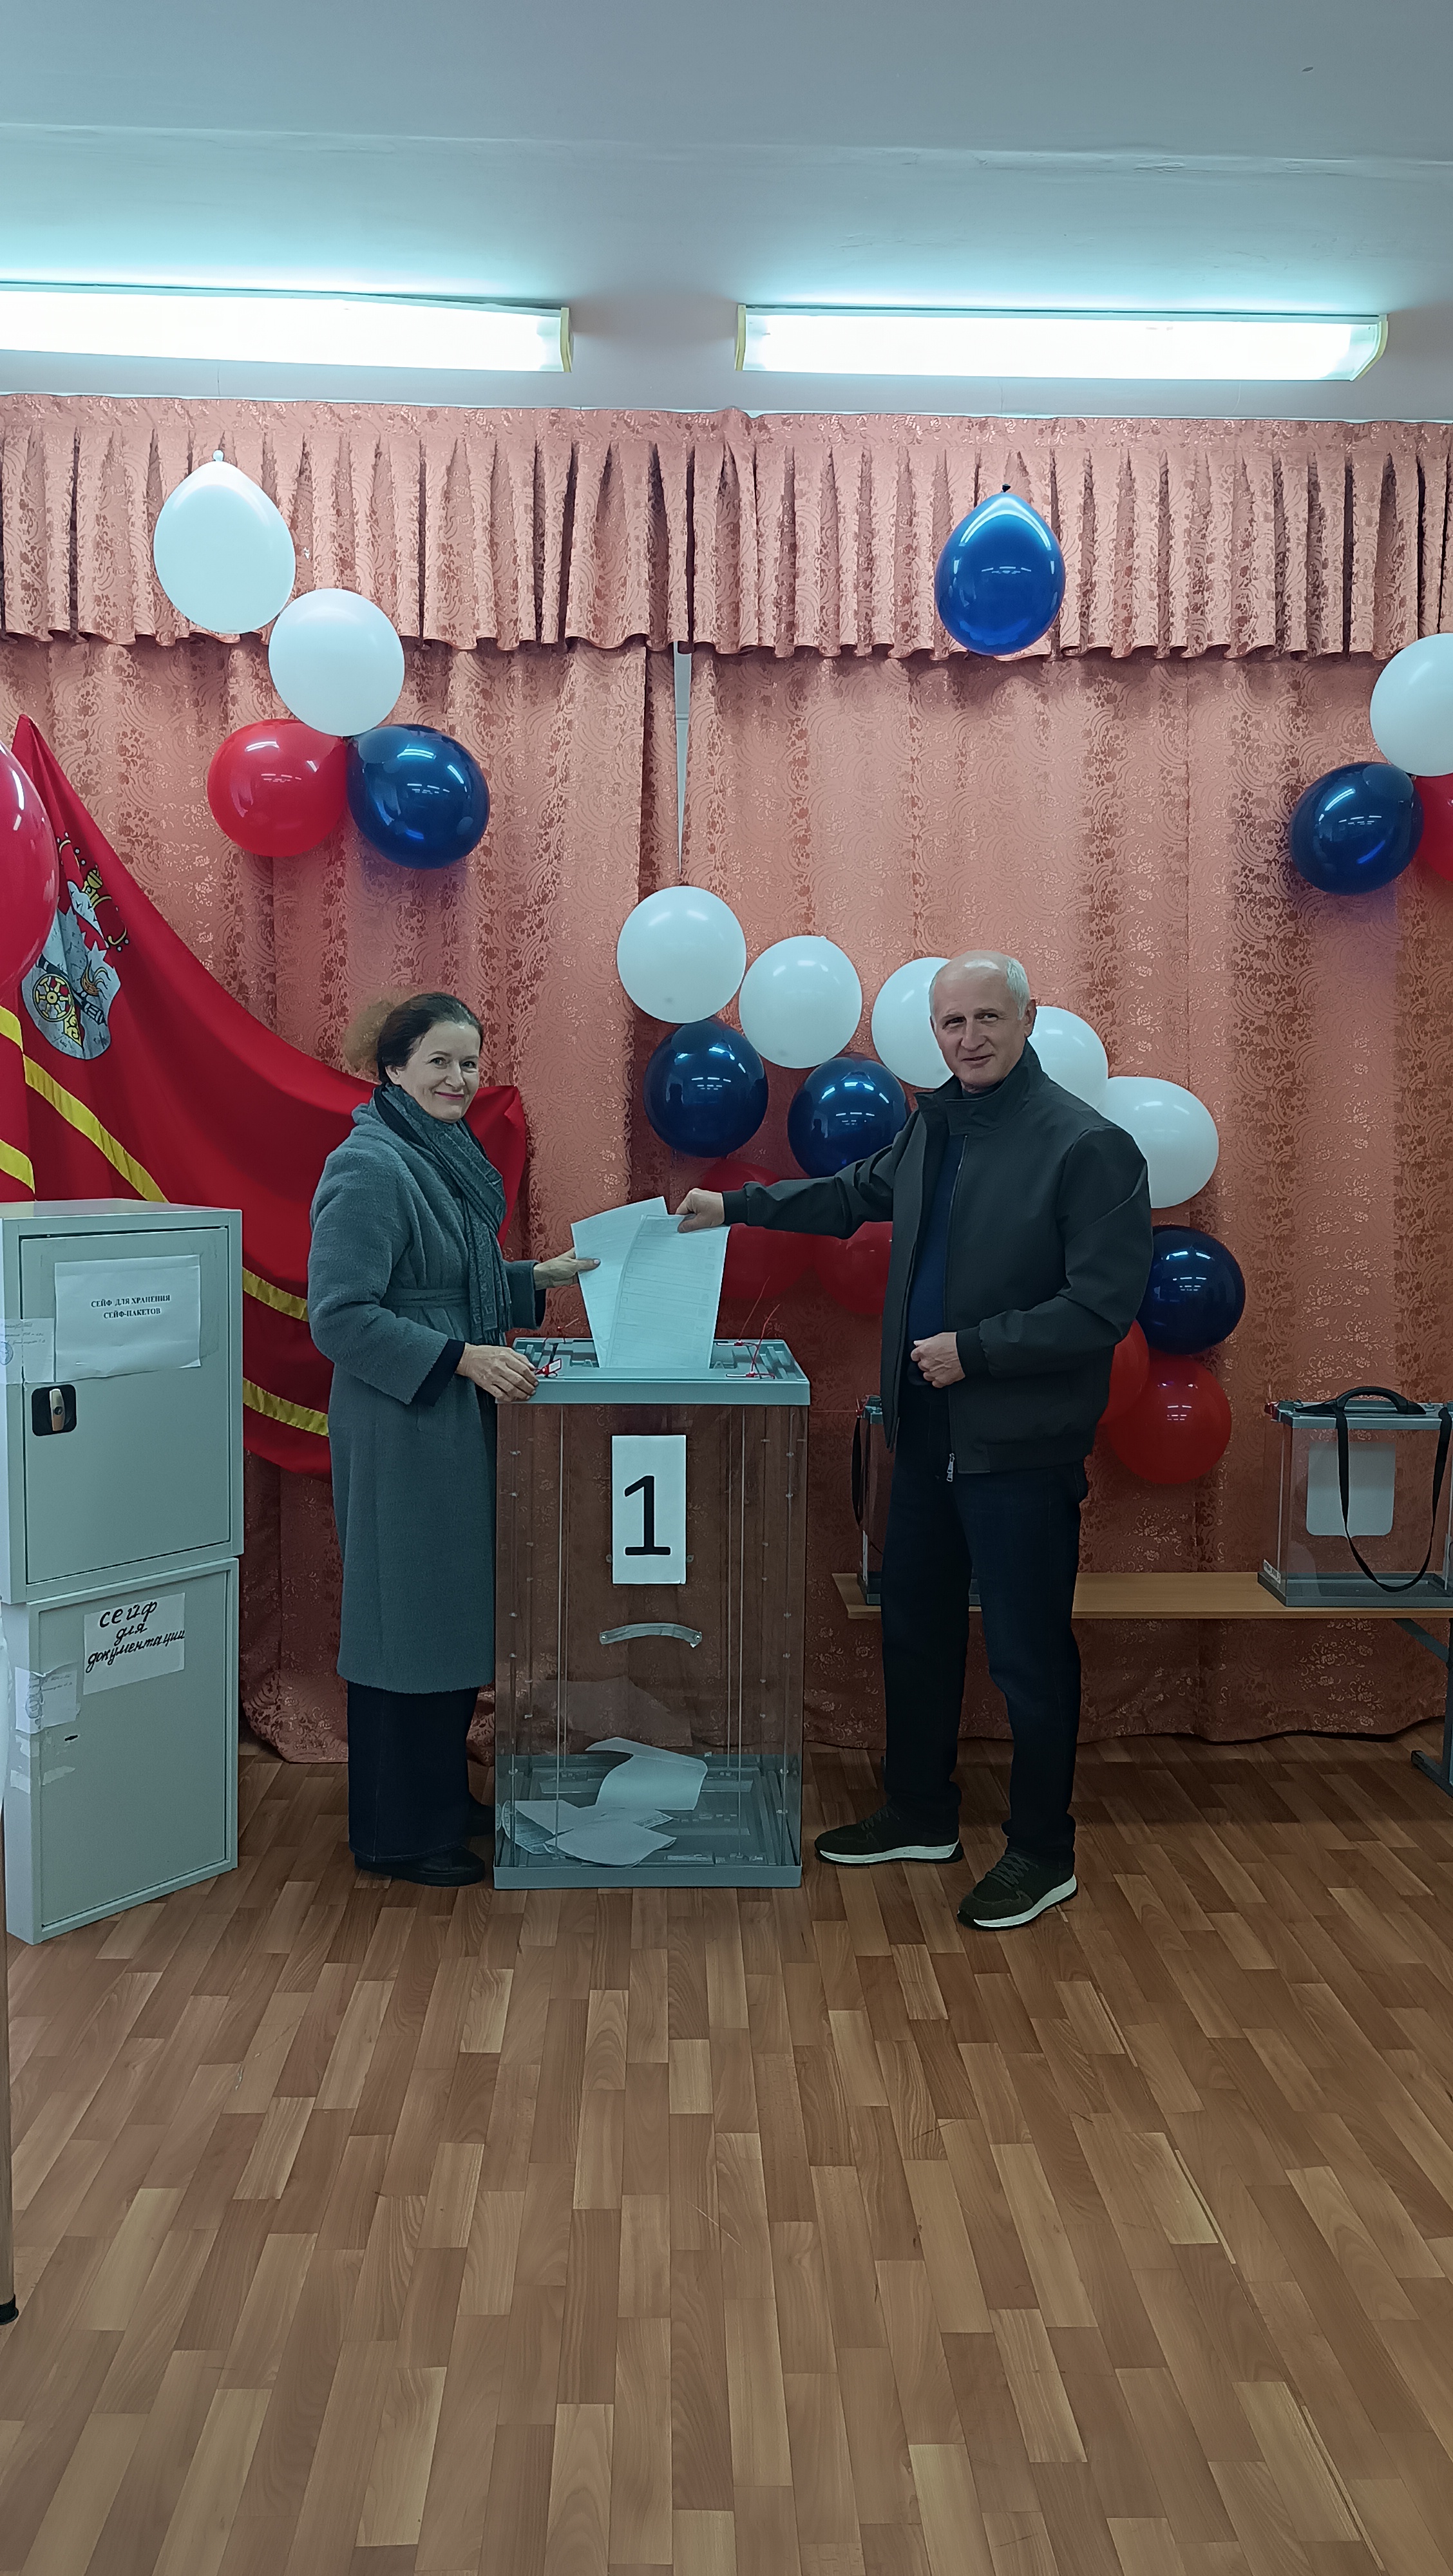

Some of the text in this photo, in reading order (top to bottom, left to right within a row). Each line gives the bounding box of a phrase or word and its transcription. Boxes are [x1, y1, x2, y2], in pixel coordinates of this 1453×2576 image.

[91, 1294, 171, 1308] СЕЙФ ДЛЯ ХРАНЕНИЯ
[103, 1307, 161, 1319] СЕЙФ-ПАКЕТОВ
[624, 1475, 671, 1556] 1
[114, 1622, 147, 1647] для
[85, 1630, 185, 1674] документации
